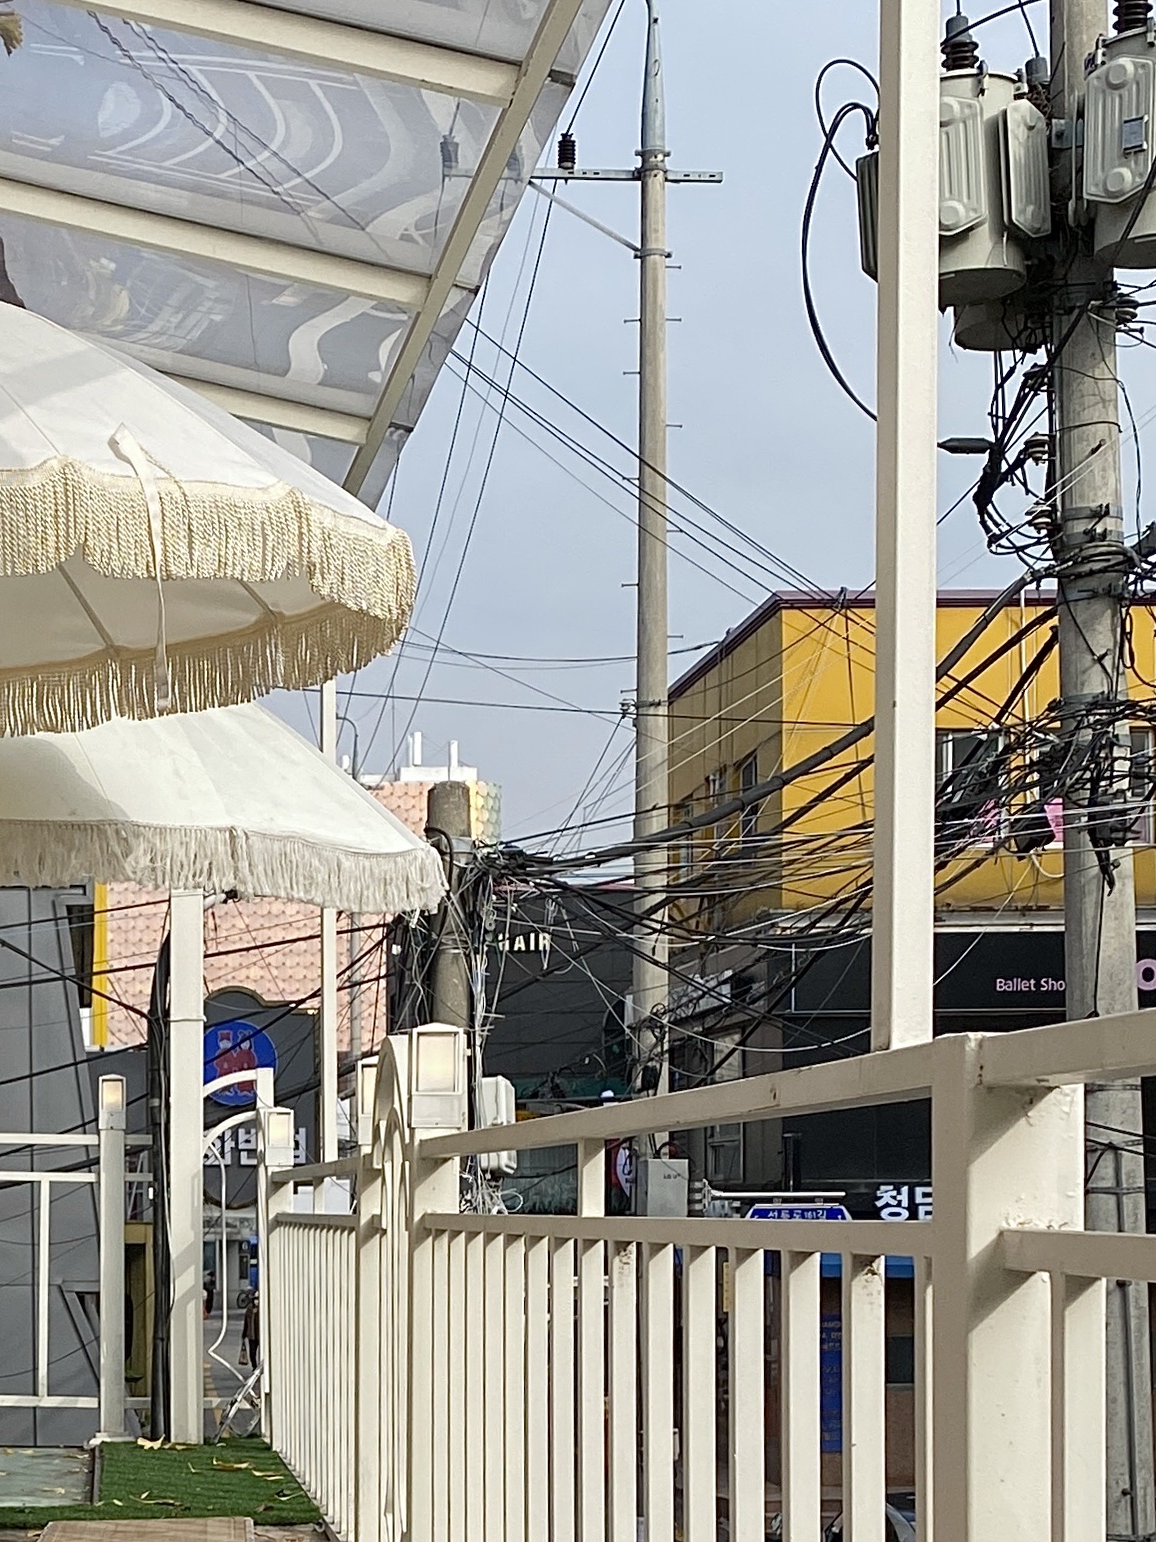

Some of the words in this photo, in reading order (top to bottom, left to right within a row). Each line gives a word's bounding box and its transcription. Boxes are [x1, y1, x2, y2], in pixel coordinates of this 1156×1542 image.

[498, 932, 551, 951] HAIR
[996, 977, 1036, 991] Ballet
[1040, 977, 1066, 991] Sho
